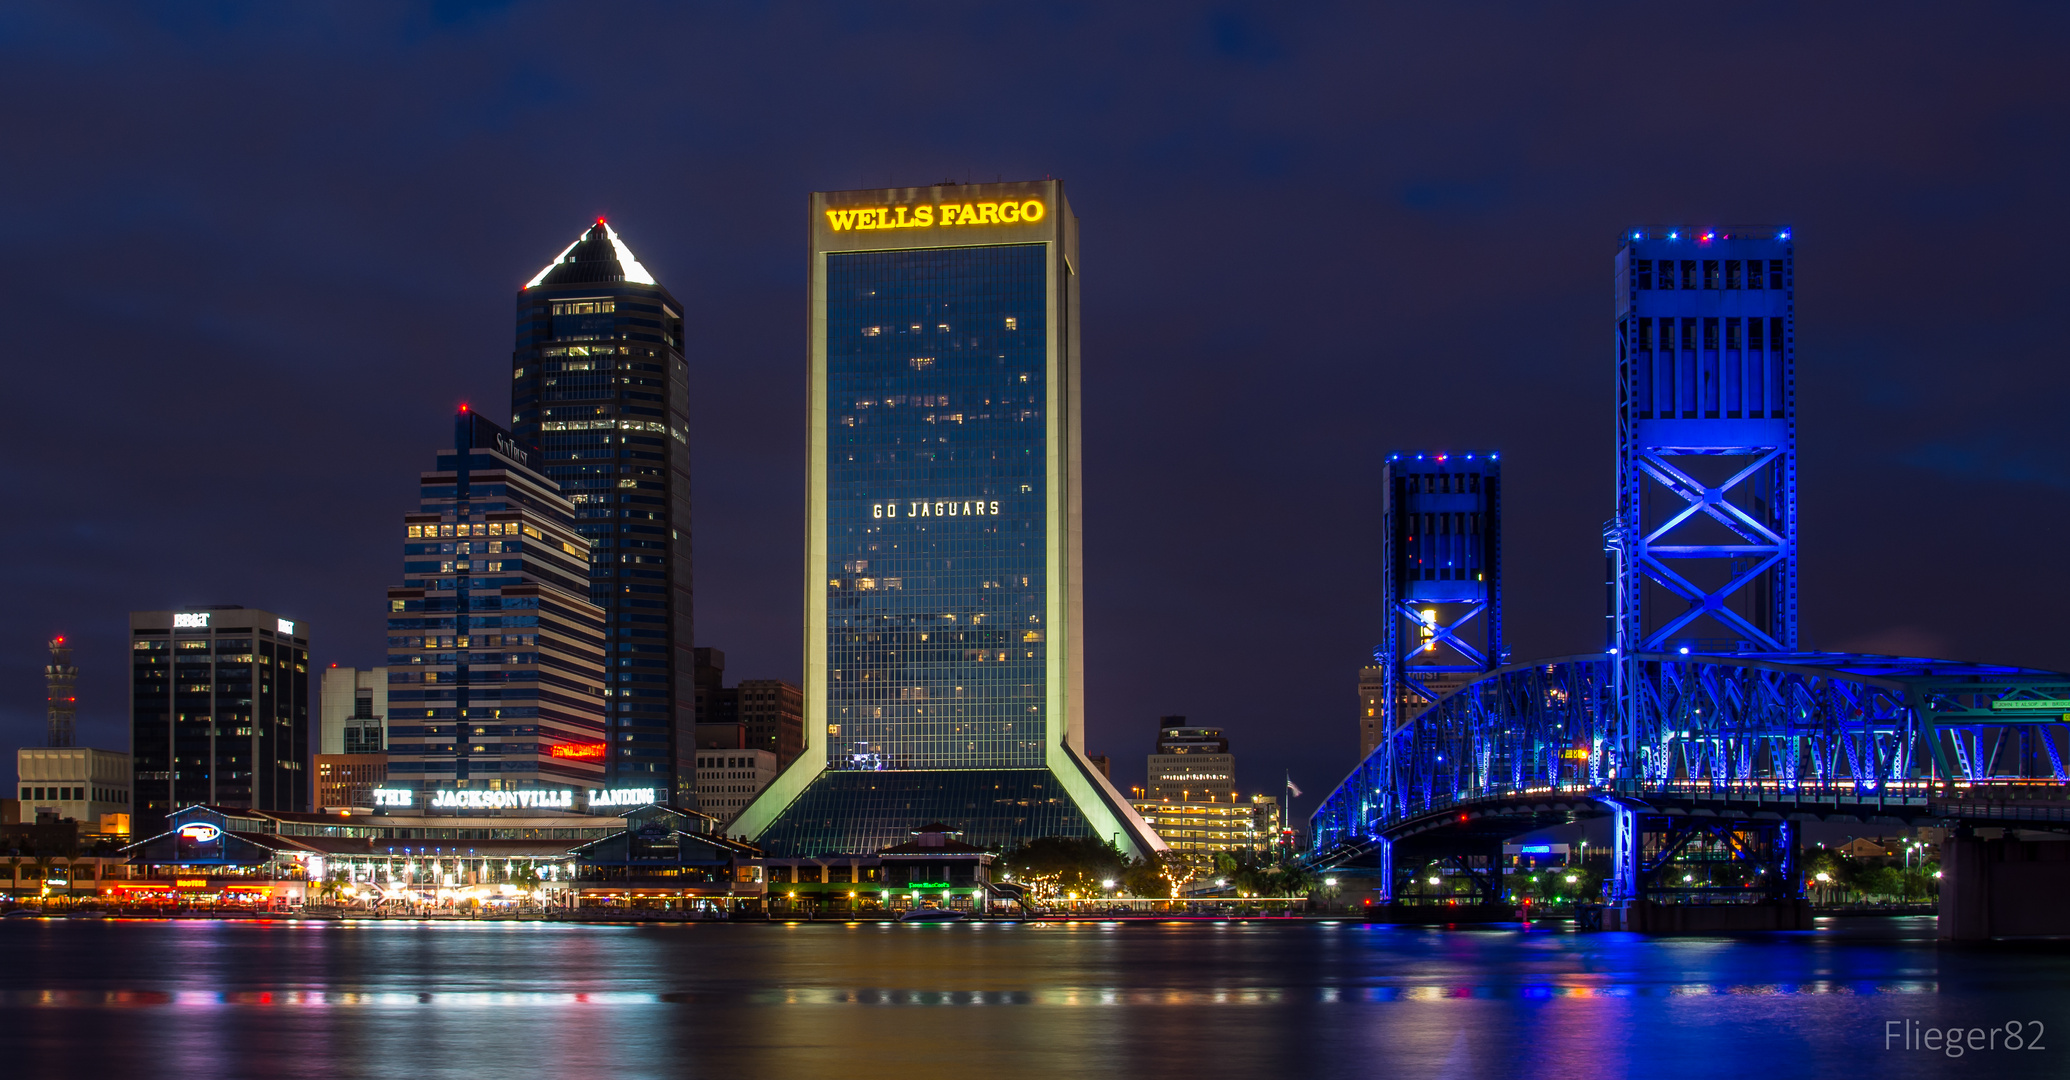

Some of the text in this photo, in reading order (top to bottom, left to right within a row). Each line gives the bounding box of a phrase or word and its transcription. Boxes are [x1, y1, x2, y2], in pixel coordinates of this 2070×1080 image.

[826, 200, 1044, 231] WELLS FARGO
[873, 501, 999, 519] GO JAGUARS
[173, 613, 210, 627] BB&T
[373, 787, 655, 807] THE JACKSONVILLE LANDING
[176, 879, 207, 887] HOOTERS
